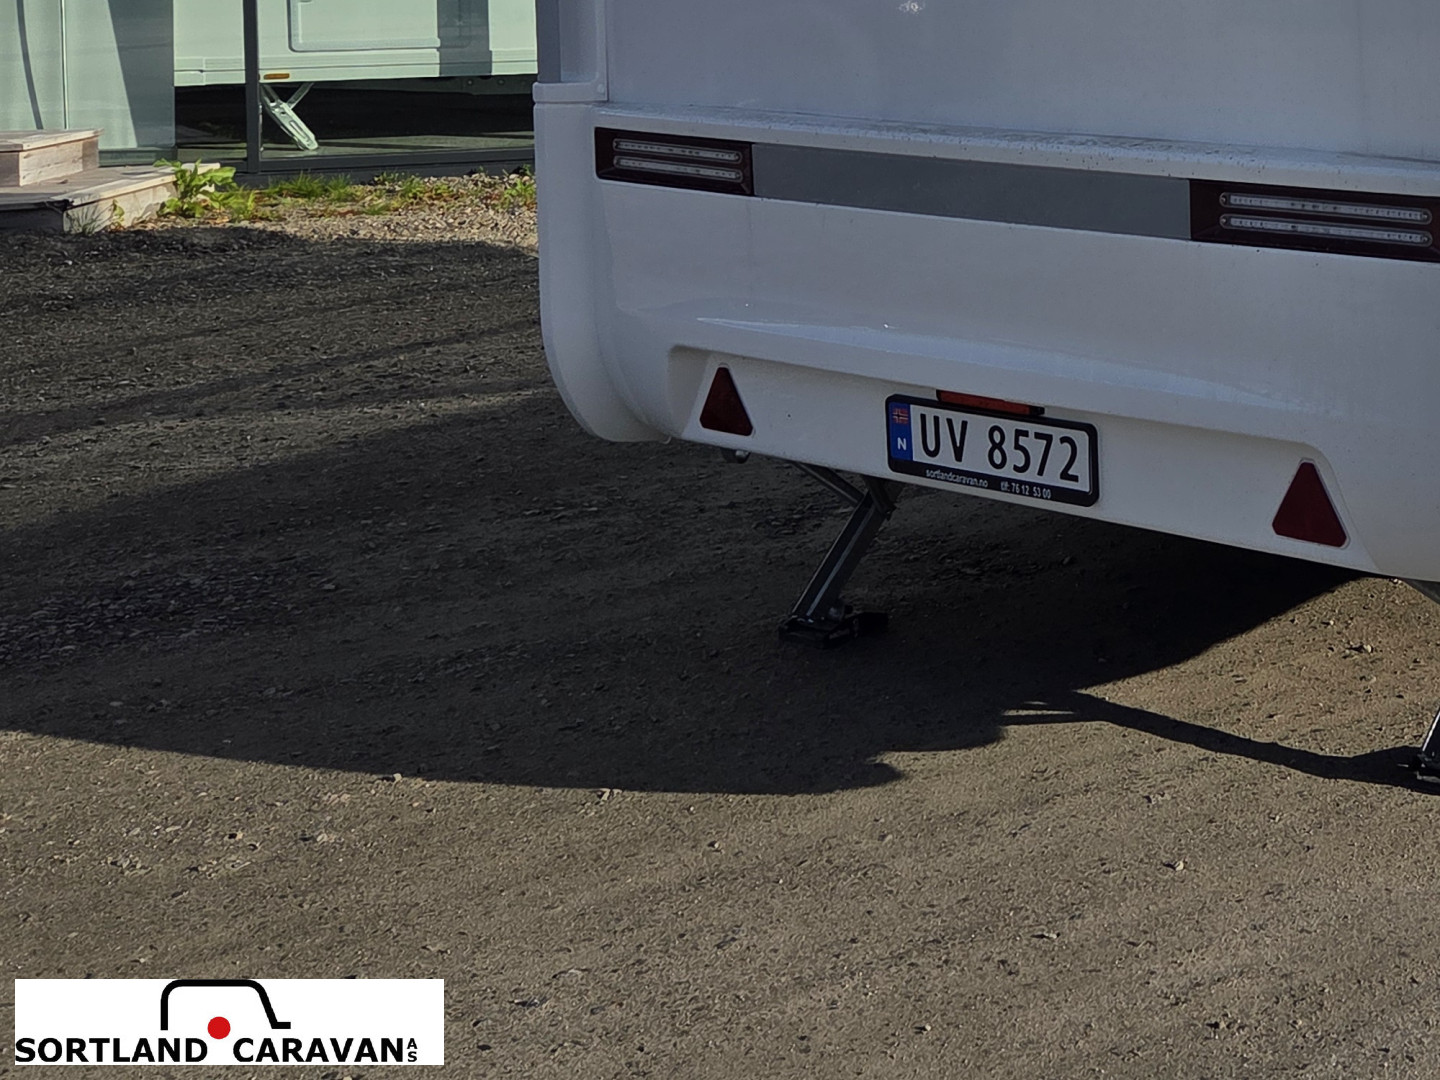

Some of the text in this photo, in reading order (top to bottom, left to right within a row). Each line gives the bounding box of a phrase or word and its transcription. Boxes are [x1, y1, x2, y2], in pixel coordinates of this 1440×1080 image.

[897, 437, 907, 451] N
[919, 413, 1079, 483] UV 8572
